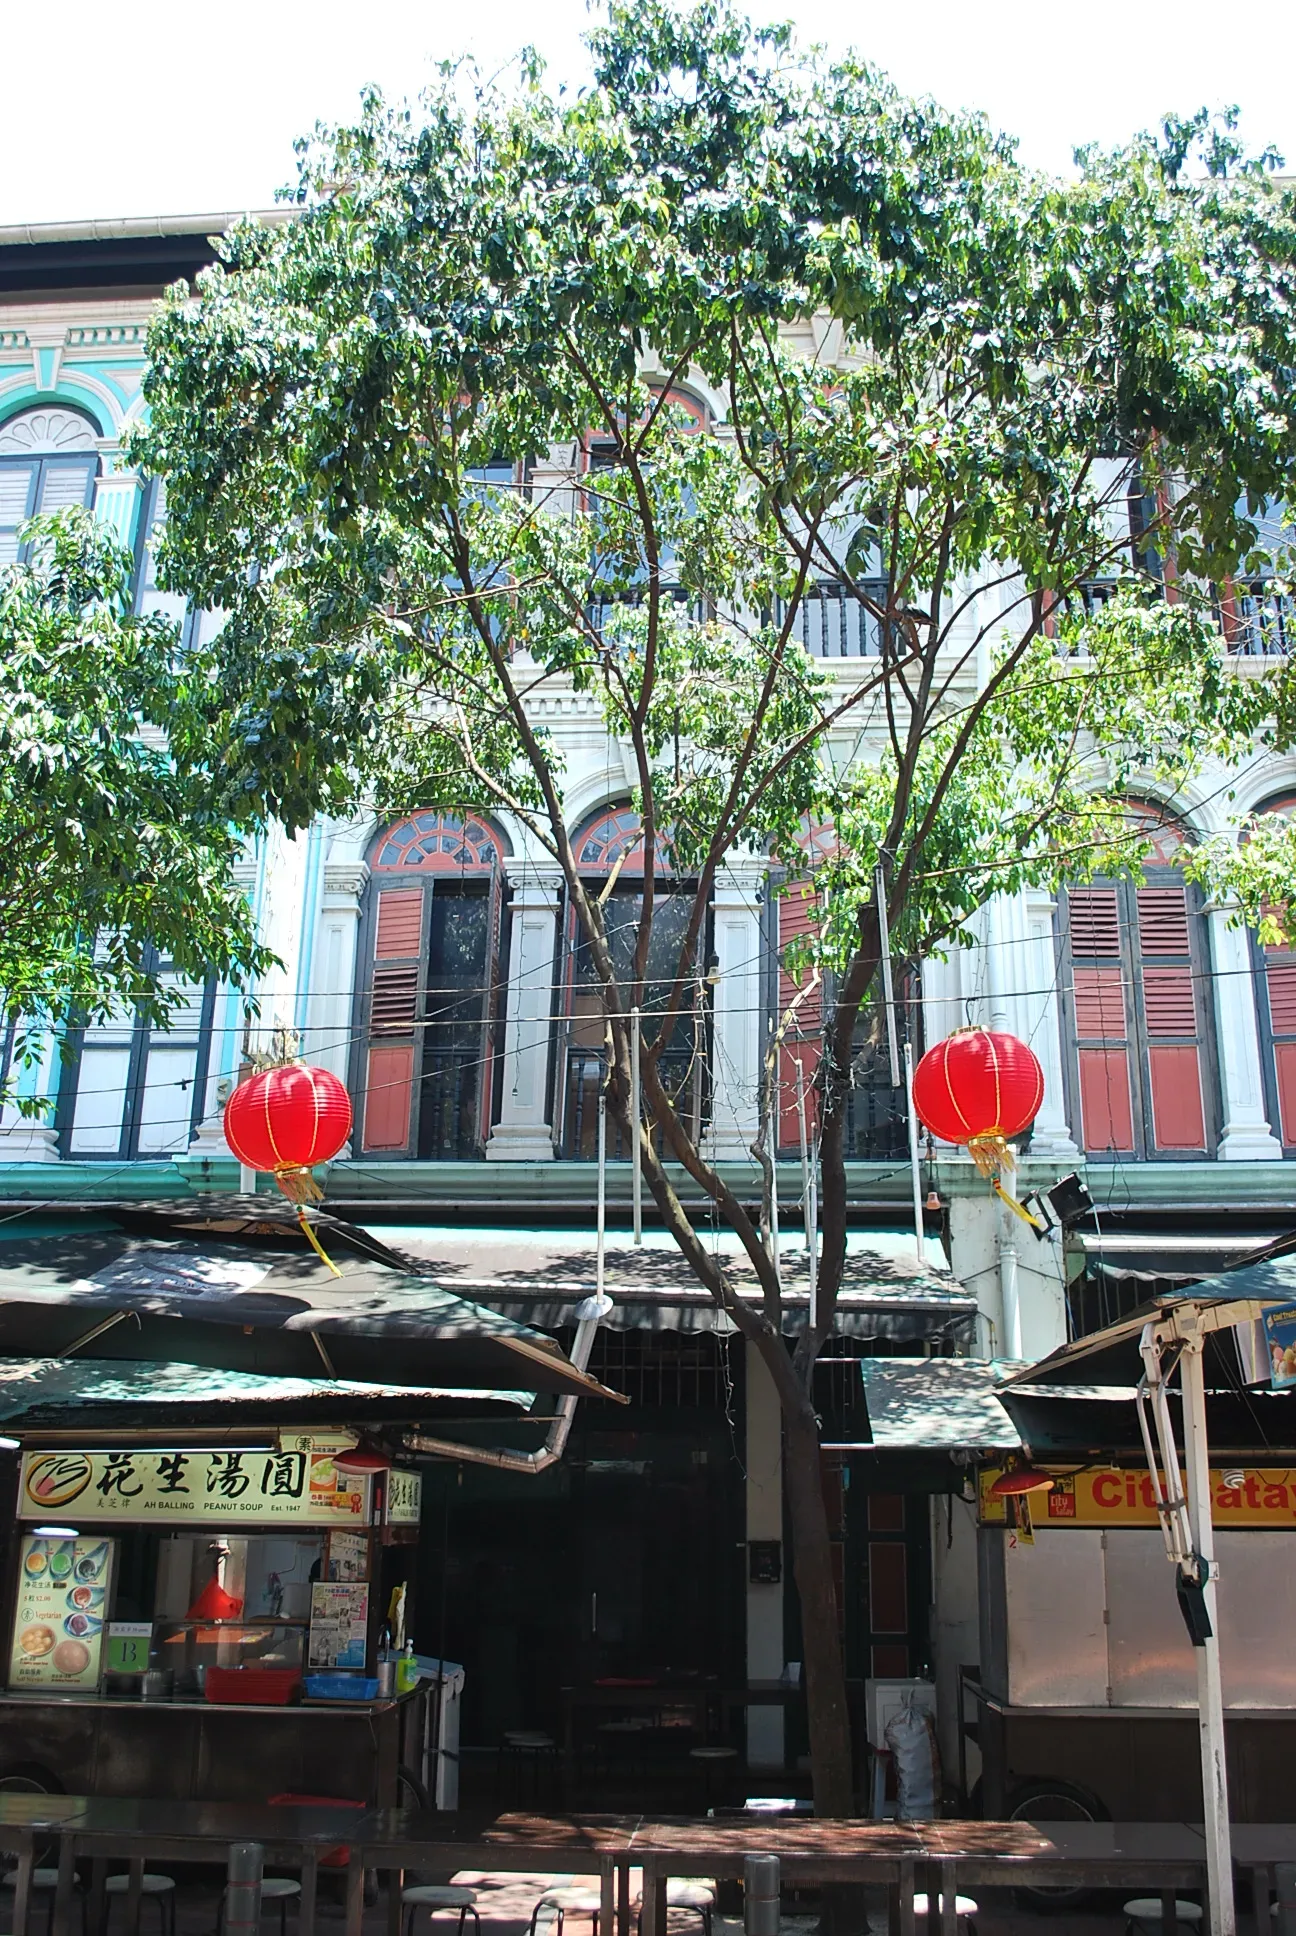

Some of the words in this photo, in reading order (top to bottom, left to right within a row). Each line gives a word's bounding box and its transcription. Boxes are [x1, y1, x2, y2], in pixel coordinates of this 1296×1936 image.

[299, 1437, 311, 1452] 素
[144, 1501, 156, 1509] AH
[158, 1502, 195, 1510] BALLING
[203, 1502, 237, 1511] PEANUT
[239, 1503, 263, 1511] SOUP
[1050, 1494, 1068, 1508] City
[35, 1611, 62, 1620] Vegetarian
